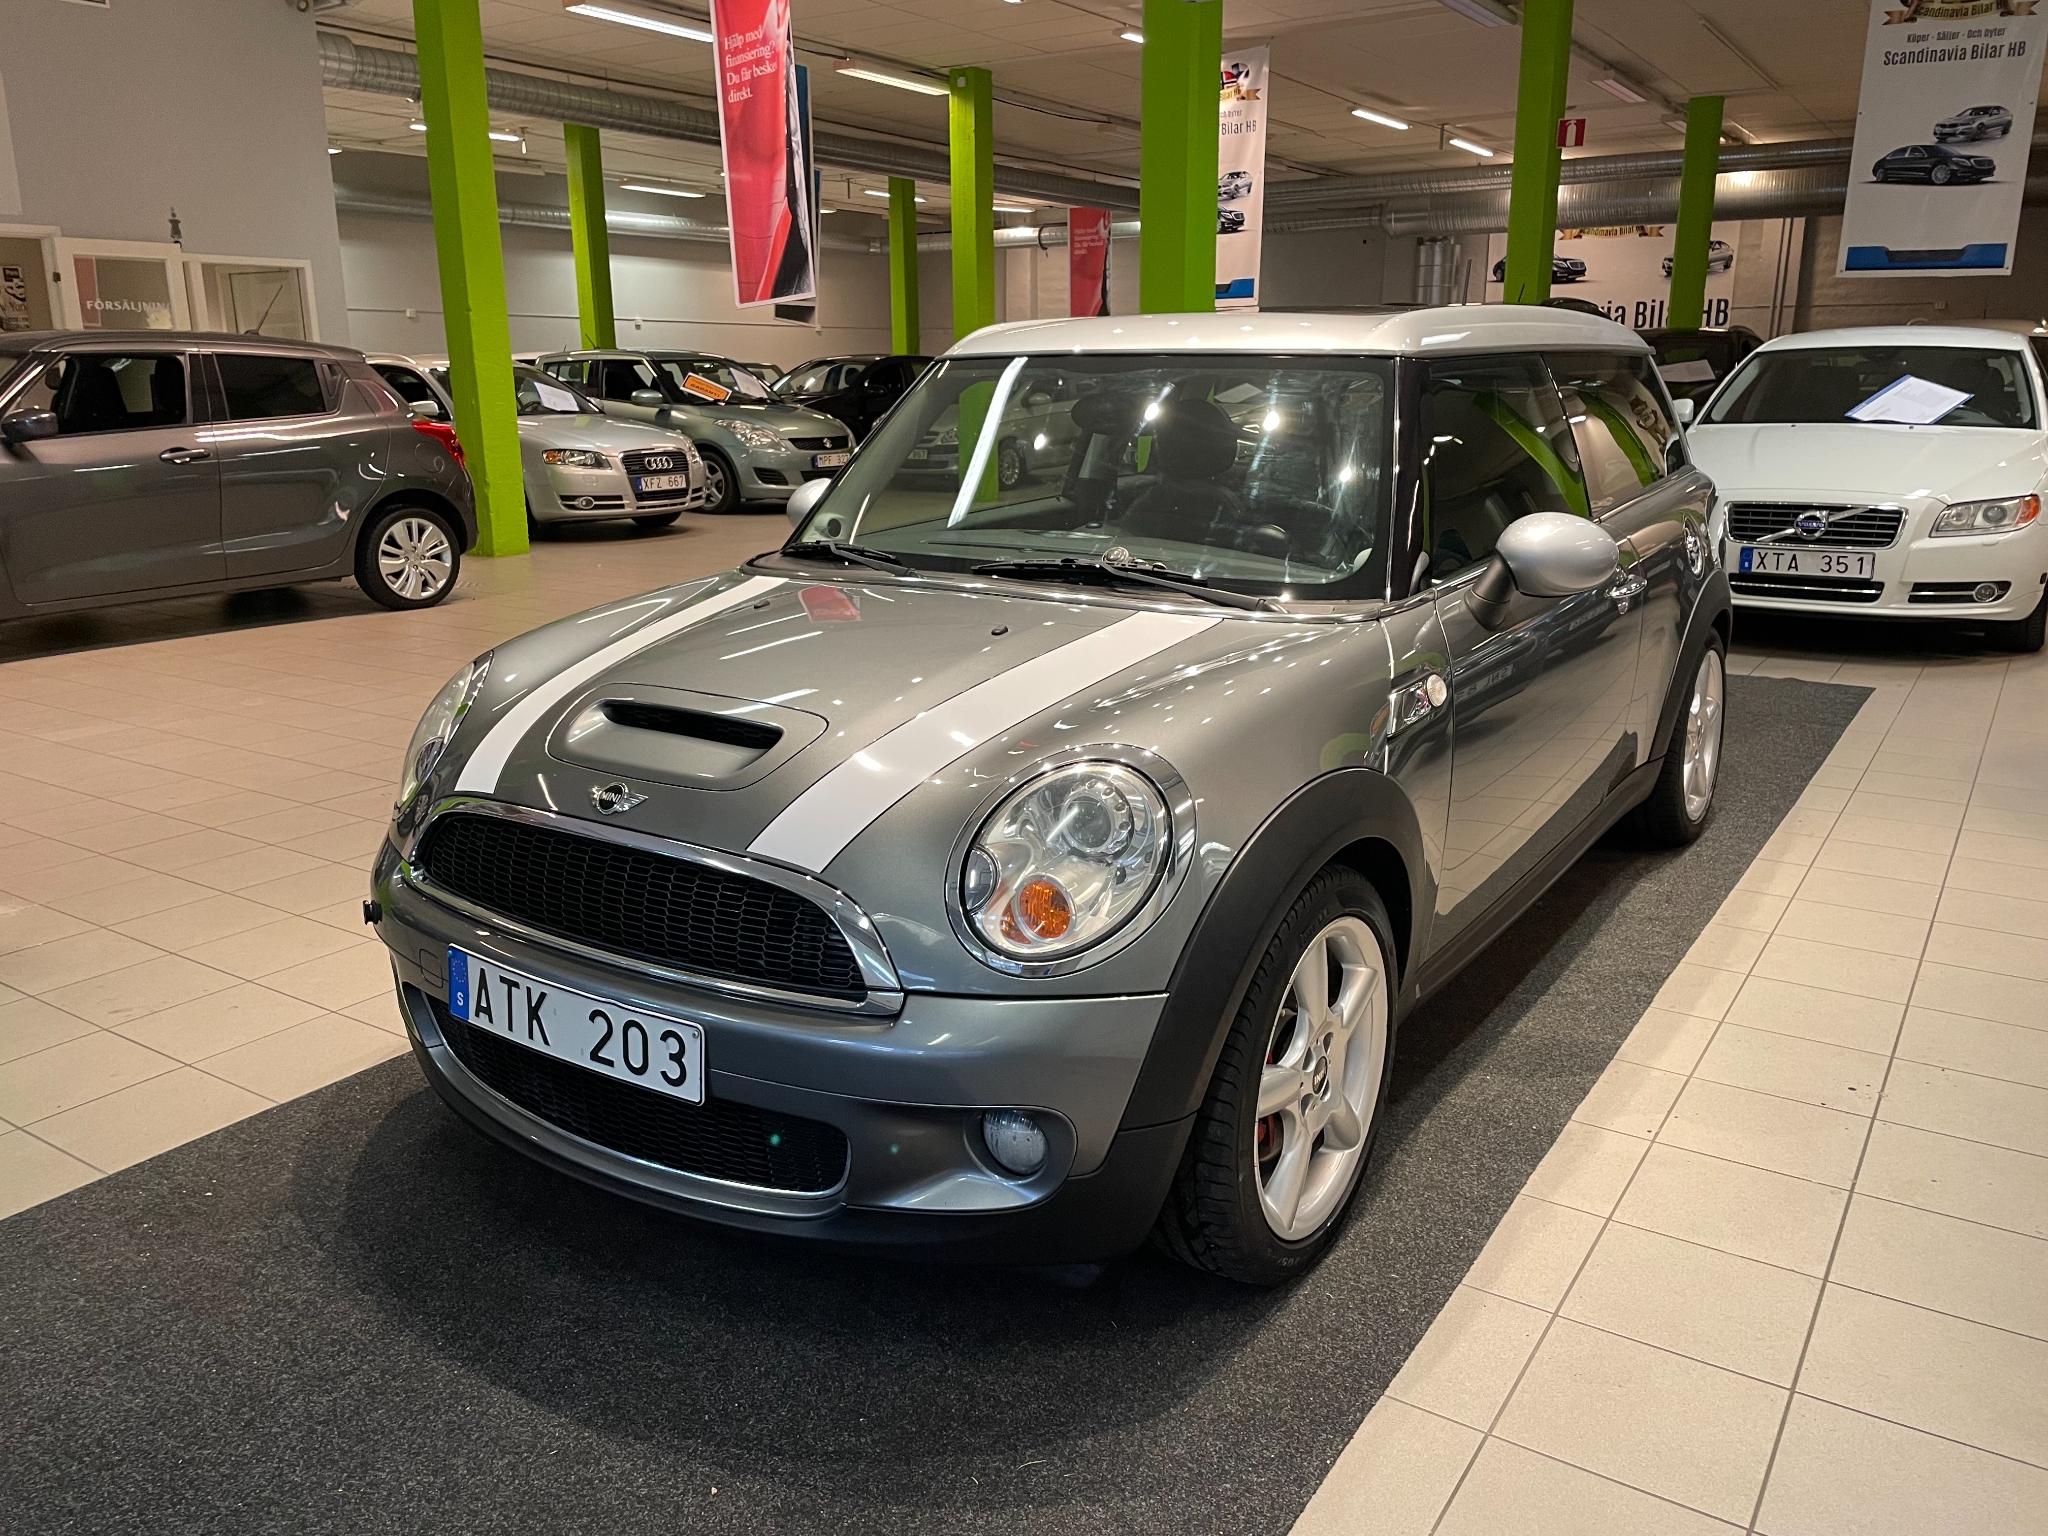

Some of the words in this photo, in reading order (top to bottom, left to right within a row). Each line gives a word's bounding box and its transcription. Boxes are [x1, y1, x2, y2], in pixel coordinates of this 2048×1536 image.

[1971, 3, 1994, 16] Bilar
[724, 32, 744, 52] Hjälp
[745, 25, 763, 42] med
[1906, 33, 1930, 43] Köper
[1936, 30, 1960, 41] Säljer
[1967, 29, 1982, 39] Och
[1983, 27, 2007, 38] byter
[725, 40, 776, 68] finansiering?
[1883, 46, 1967, 66] Scandinavia
[1971, 43, 2005, 60] Bilar
[2007, 40, 2026, 57] HB
[726, 72, 740, 86] Du
[740, 67, 752, 82] får
[1221, 122, 1243, 135] Bilar
[1245, 120, 1257, 133] HB
[643, 477, 662, 490] XFZ
[667, 475, 684, 488] 667
[1756, 551, 1799, 572] XTA
[1820, 555, 1865, 575] 351
[600, 791, 621, 803] MINI
[457, 992, 464, 1006] S
[474, 967, 551, 1046] ATK
[588, 1009, 687, 1087] 203
